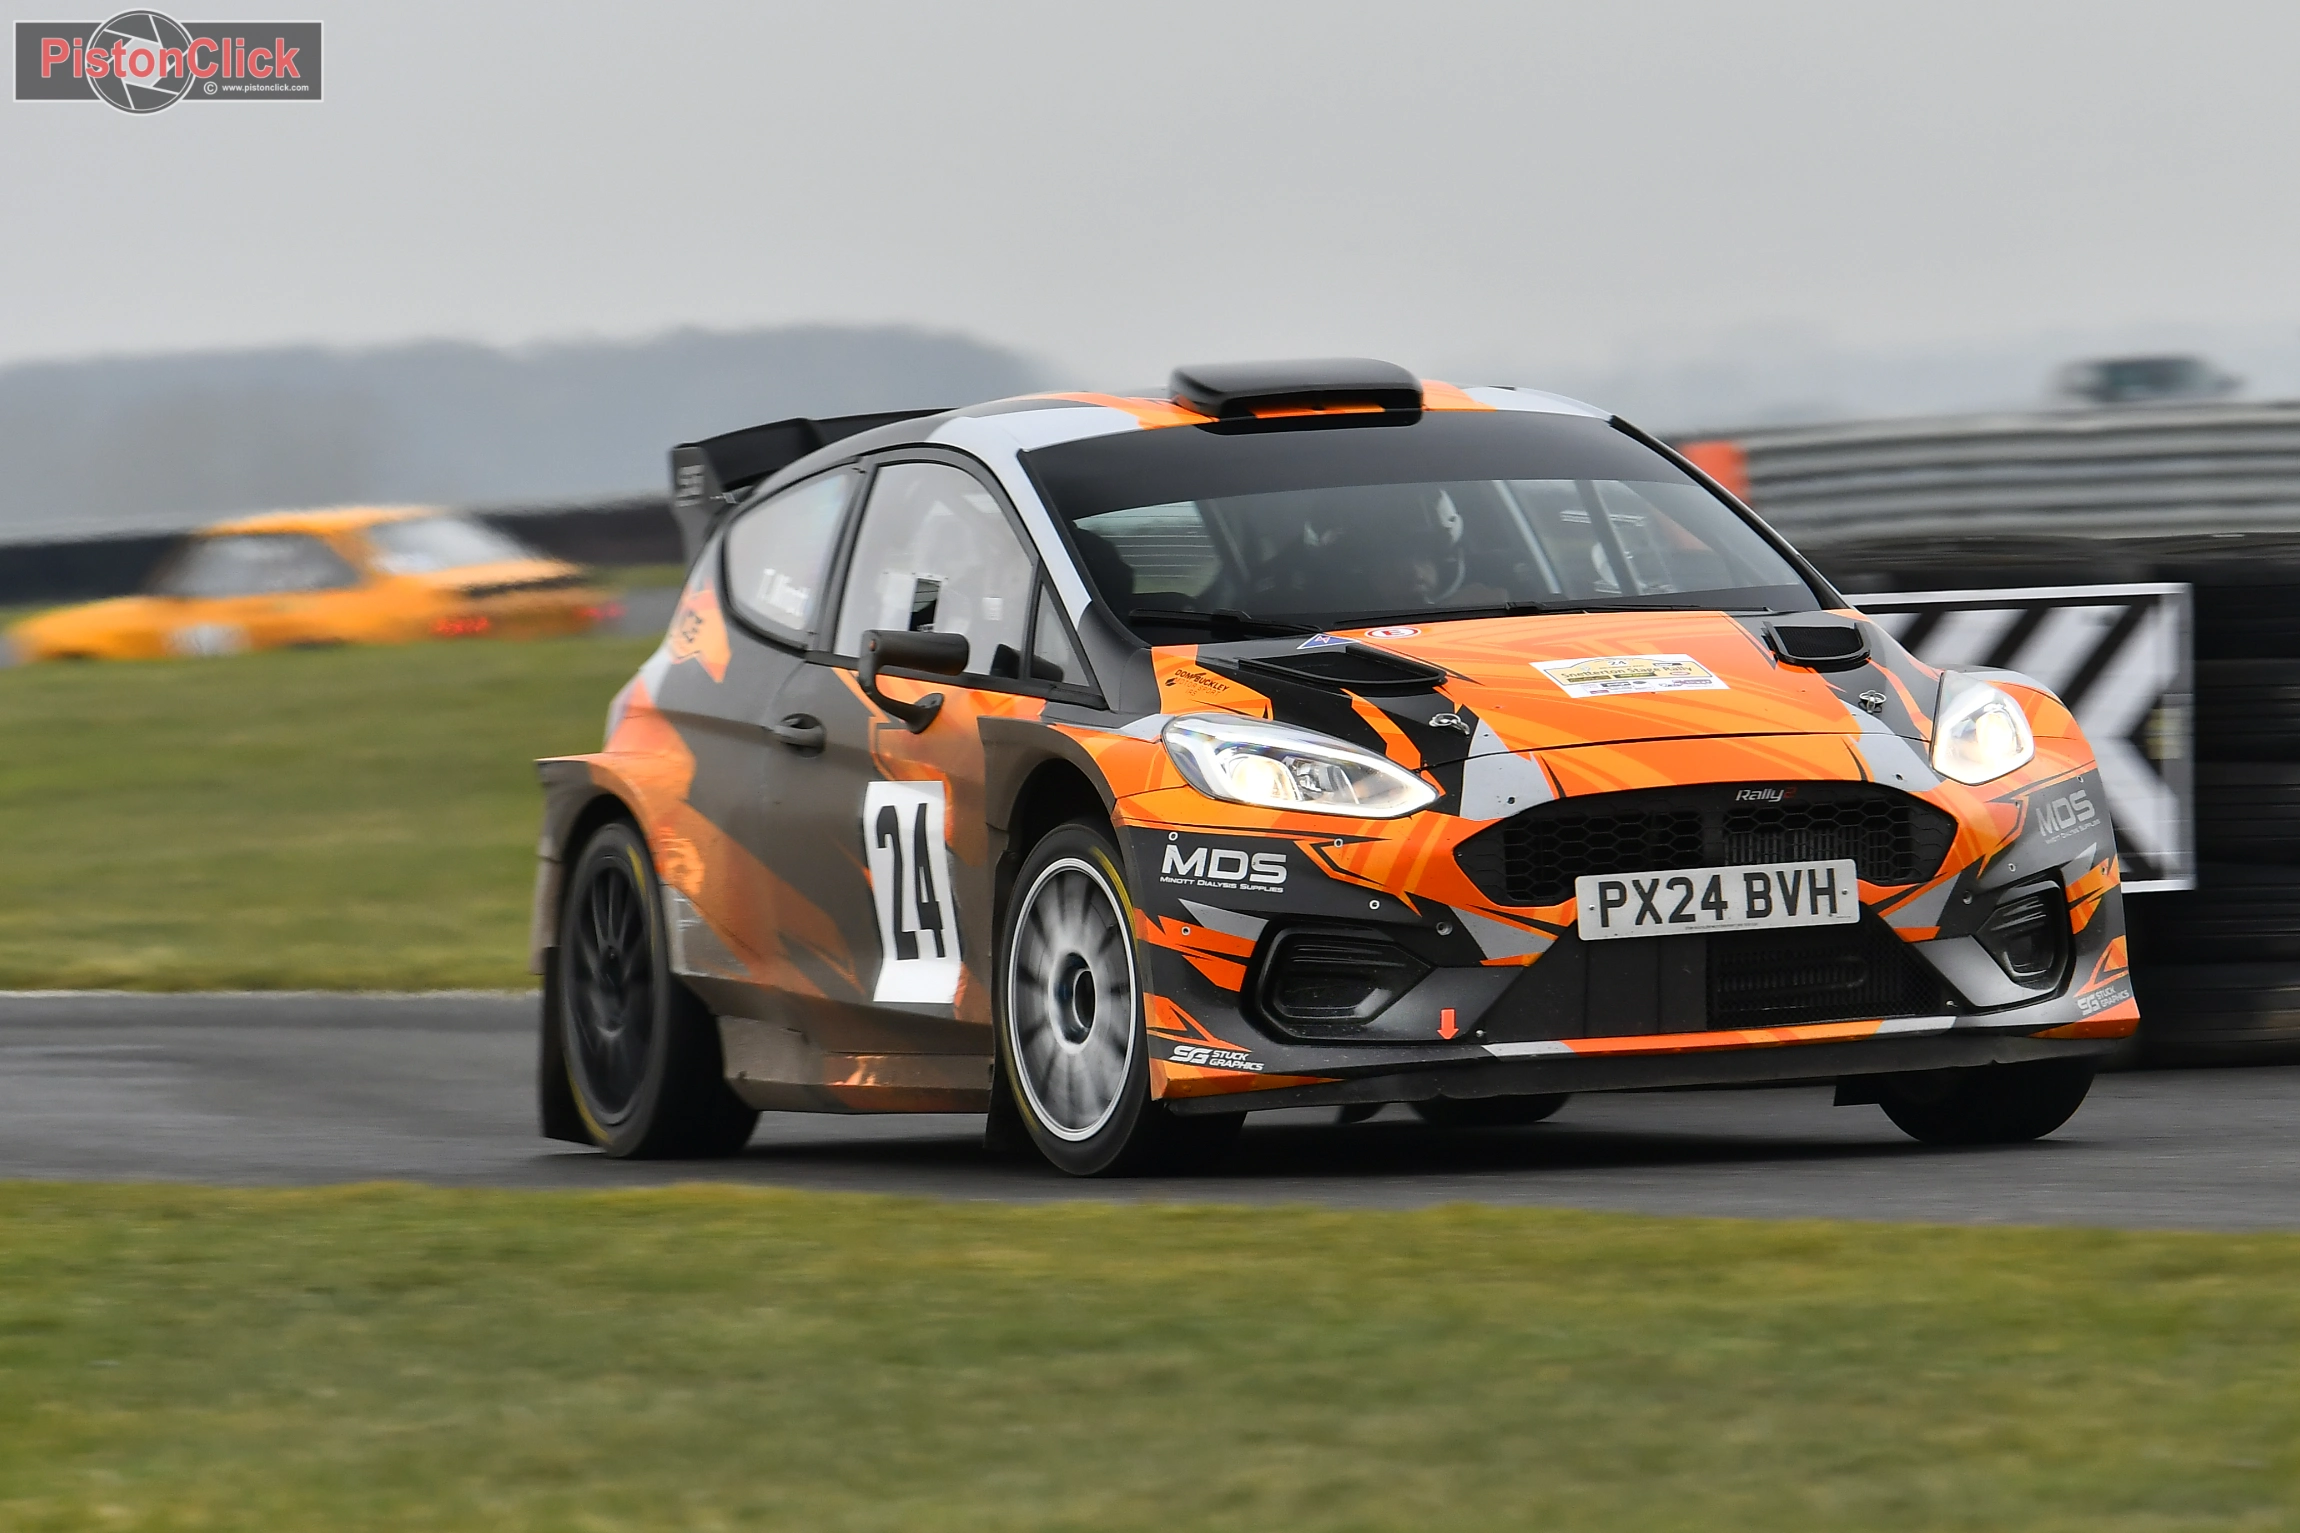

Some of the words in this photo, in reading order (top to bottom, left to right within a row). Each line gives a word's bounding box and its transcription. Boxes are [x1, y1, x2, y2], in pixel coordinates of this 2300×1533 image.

[1561, 668, 1626, 678] Snetterton
[1663, 665, 1692, 673] Rally
[1193, 675, 1230, 692] BUCKLEY
[2035, 789, 2096, 837] MDS
[1161, 844, 1287, 884] MDS
[876, 803, 945, 960] 24
[1160, 876, 1195, 885] MINOTT
[1197, 880, 1237, 889] DIALYSIS
[1240, 883, 1284, 893] SUPPLIES
[1598, 874, 1729, 928] PX24
[1743, 868, 1837, 919] BVH
[2095, 985, 2117, 1000] STUCK
[2100, 989, 2130, 1008] GRAPHICS
[1211, 1050, 1249, 1060] STUCK
[1209, 1059, 1264, 1071] GRAPHICS
